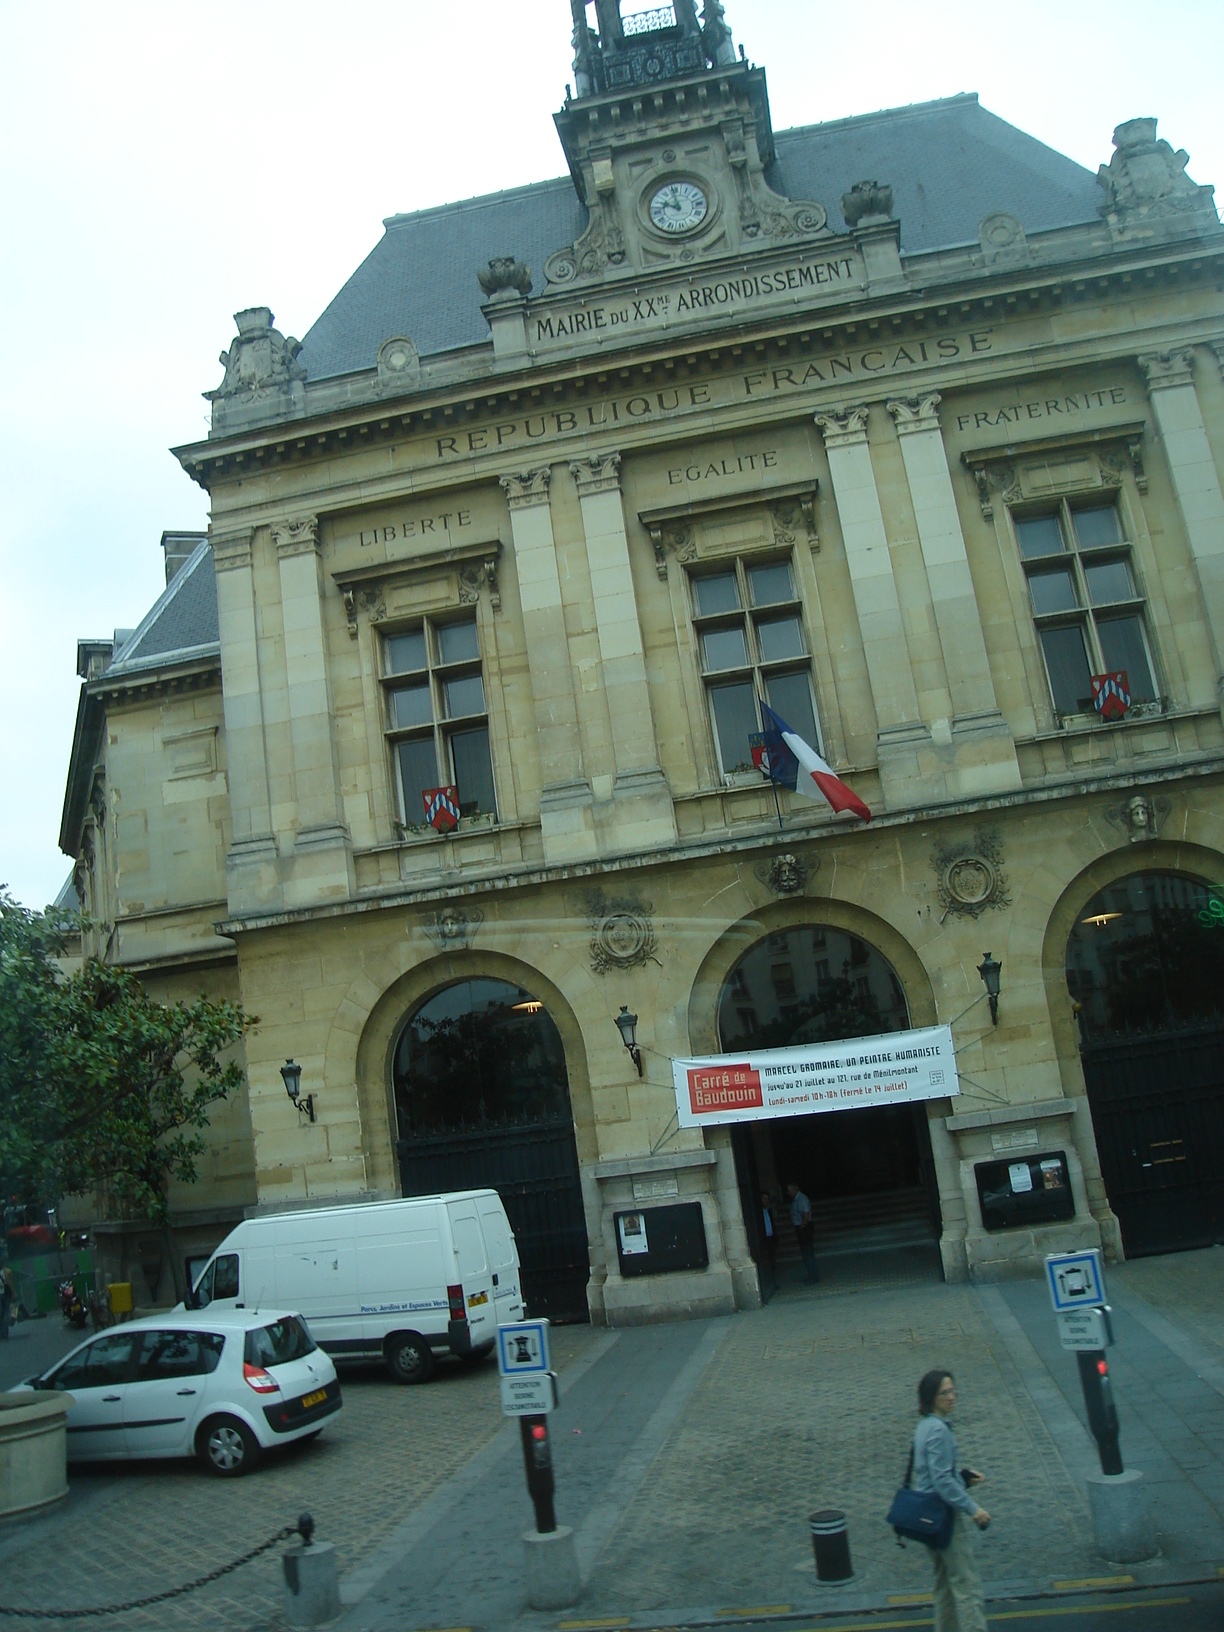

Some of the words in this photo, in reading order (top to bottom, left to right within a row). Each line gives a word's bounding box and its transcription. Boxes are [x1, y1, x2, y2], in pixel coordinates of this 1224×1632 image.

[537, 308, 608, 341] MAIRIE
[611, 309, 629, 325] DU
[677, 258, 854, 313] ARRONDISSEMENT
[436, 384, 712, 458] REPUBLIQUE
[957, 387, 1127, 431] FRATERNITE
[668, 451, 778, 485] EGALITE
[359, 510, 472, 547] LIBERTE
[765, 1065, 797, 1077] MARCEL
[846, 1057, 857, 1067] UN
[860, 1052, 893, 1065] PEINTRE
[895, 1046, 941, 1060] HUMANISTE
[795, 1079, 803, 1088] 21
[804, 1077, 826, 1087] juillet
[850, 1073, 861, 1081] rue
[863, 1071, 872, 1079] de
[873, 1065, 919, 1078] Ménilmontant
[693, 1071, 730, 1090] Carré
[734, 1071, 746, 1084] de
[695, 1085, 757, 1106] Baudouin
[864, 1086, 872, 1094] le
[874, 1084, 882, 1093] 14
[884, 1080, 908, 1092] juillet)
